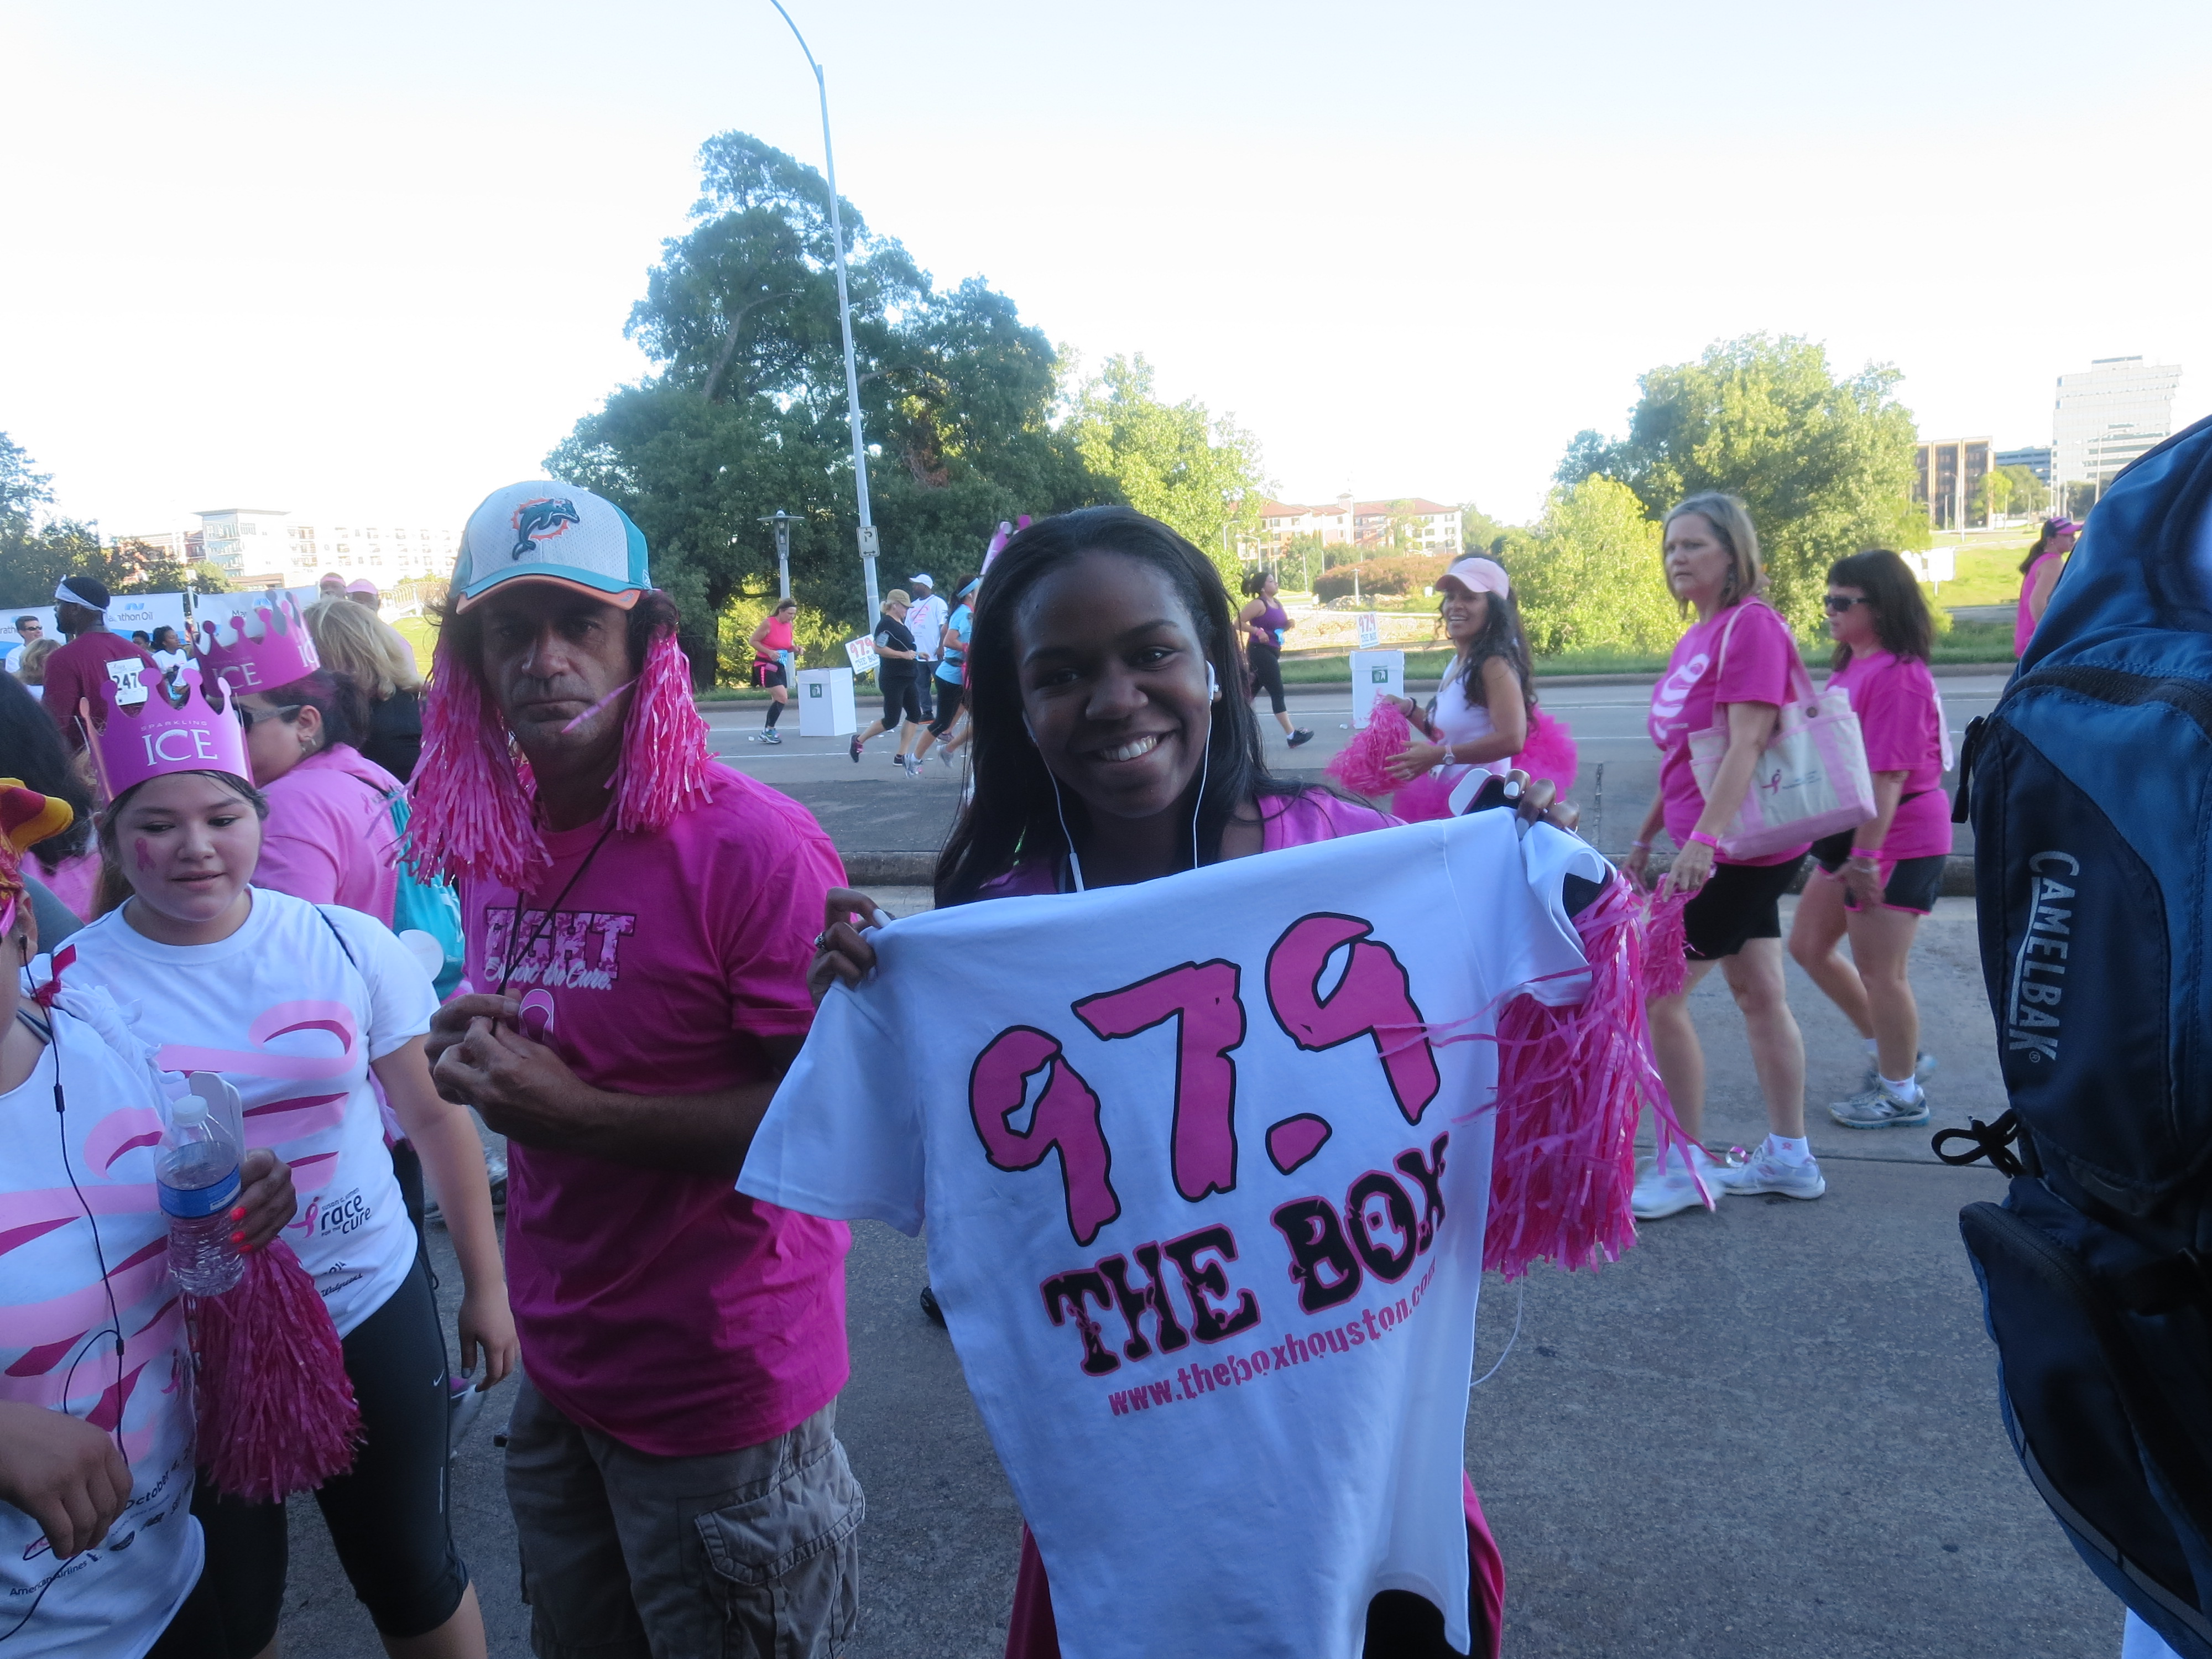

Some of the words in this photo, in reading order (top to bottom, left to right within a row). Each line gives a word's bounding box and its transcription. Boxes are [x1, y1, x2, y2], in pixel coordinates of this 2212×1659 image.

[142, 612, 153, 620] Oil
[1359, 614, 1376, 633] 97.9
[212, 662, 263, 690] ICE
[855, 657, 867, 667] THE
[140, 720, 208, 732] SPARKLING
[142, 728, 219, 766] ICE
[483, 907, 637, 980] FIGHT
[2009, 850, 2080, 1061] CAMELBAK
[968, 911, 1441, 1248] 97.9
[321, 1194, 364, 1231] race
[342, 1207, 372, 1234] cure
[1039, 1223, 1261, 1377] THE
[1270, 1131, 1449, 1314] BOX
[1109, 1255, 1437, 1416] www.theboxhouston.com
